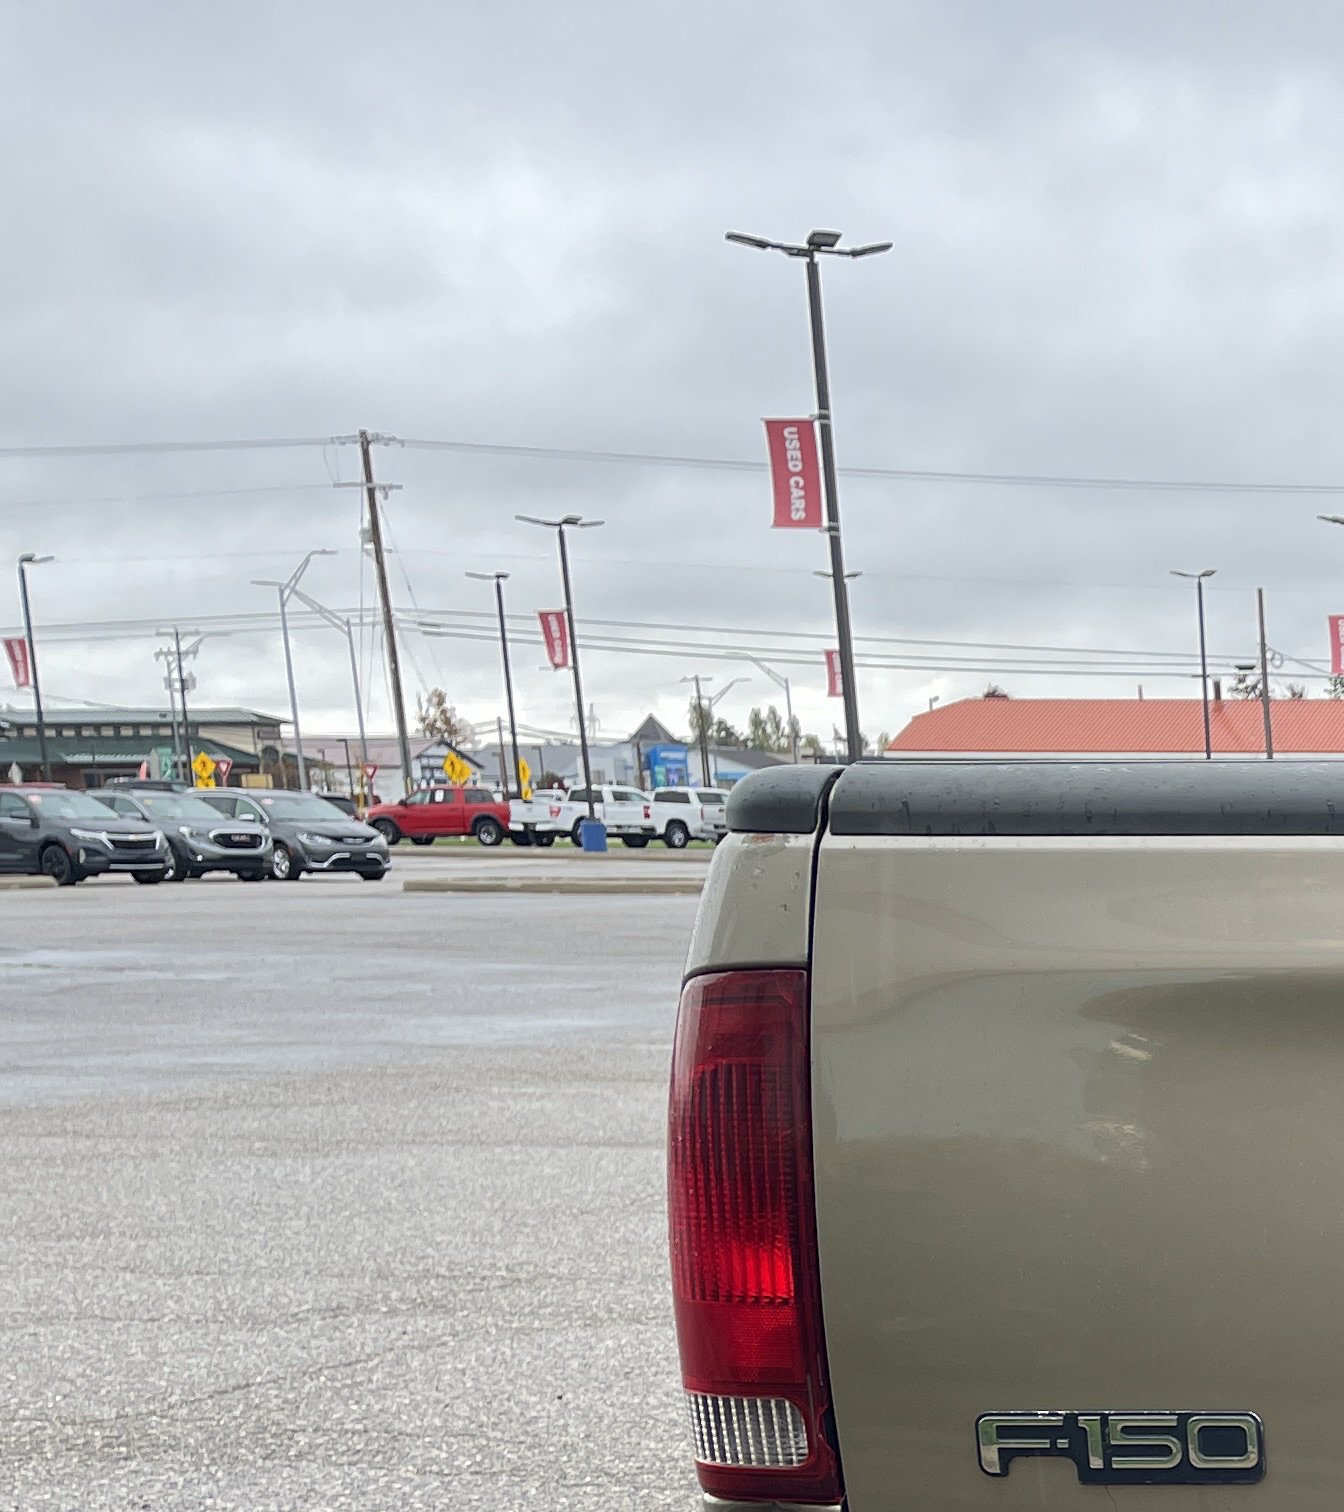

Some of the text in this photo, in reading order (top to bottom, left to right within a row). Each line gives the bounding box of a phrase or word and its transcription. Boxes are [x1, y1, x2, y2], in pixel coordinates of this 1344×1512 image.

[783, 426, 806, 521] USED CARS
[978, 1415, 1260, 1474] F-150
